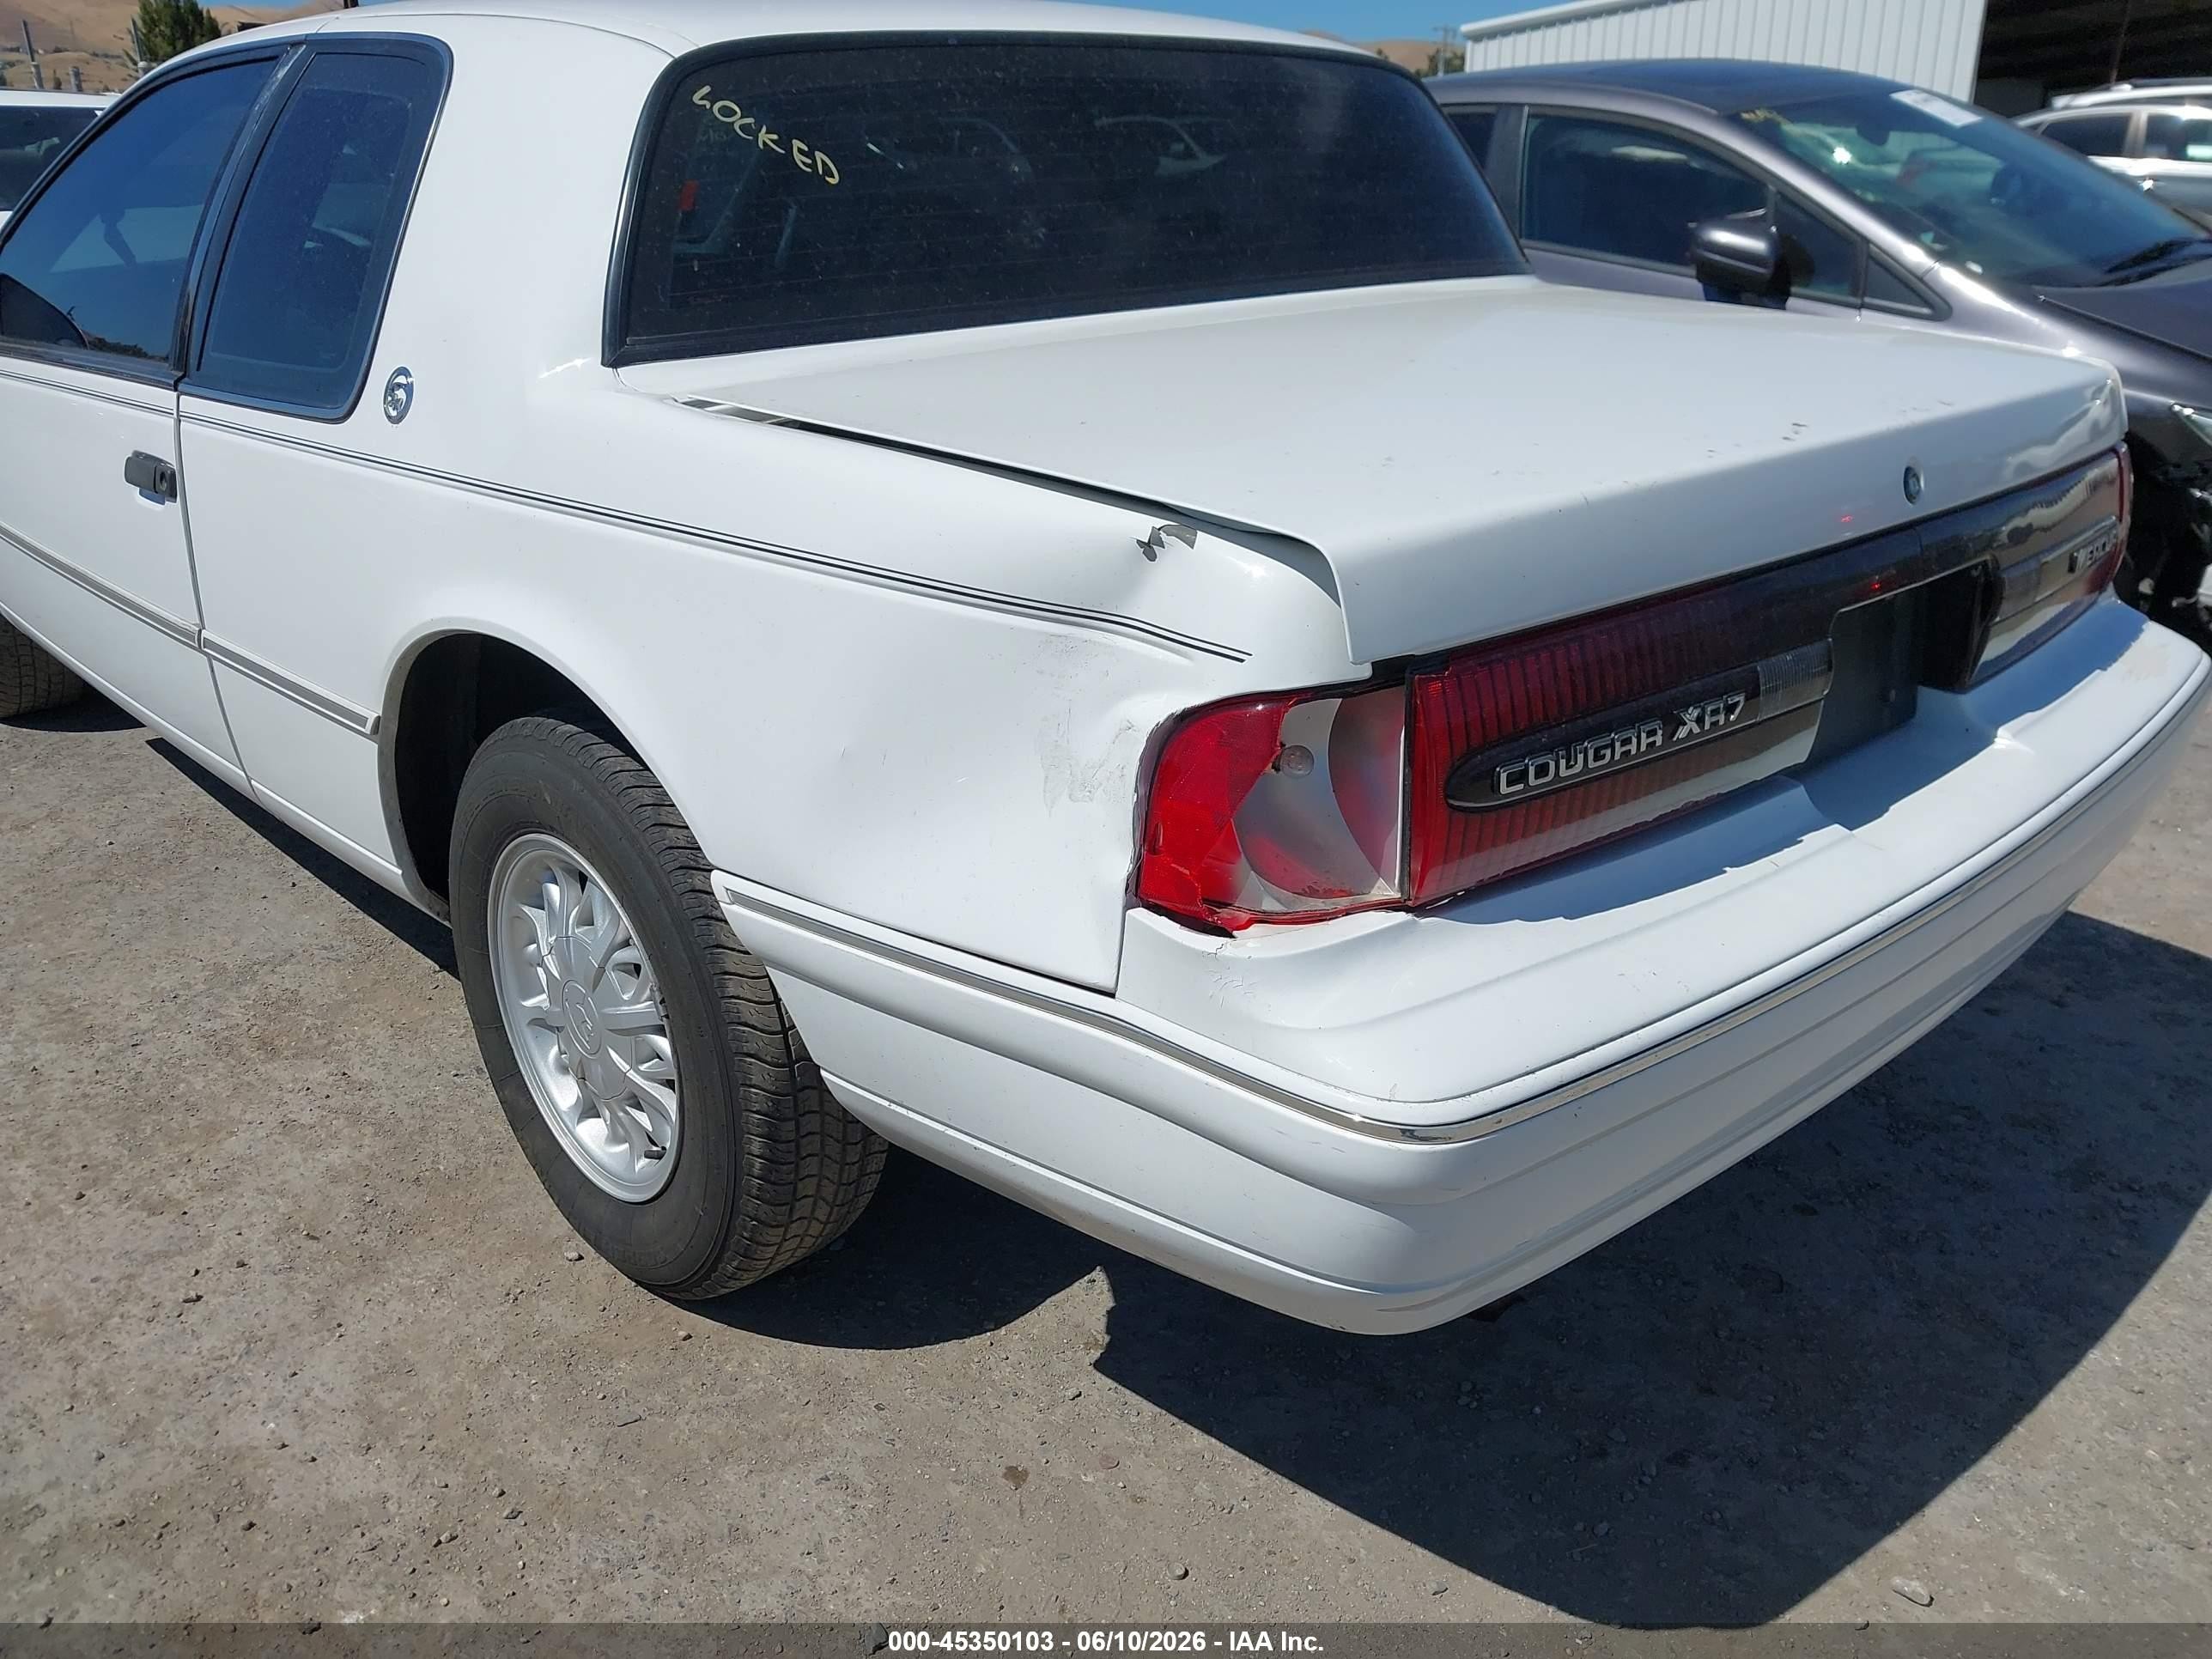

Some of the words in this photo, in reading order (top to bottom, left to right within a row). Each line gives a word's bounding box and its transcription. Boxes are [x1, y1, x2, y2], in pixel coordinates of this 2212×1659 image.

[692, 85, 840, 185] LOCKED
[1495, 718, 1663, 795] COUGAR
[1674, 691, 1746, 742] XR7
